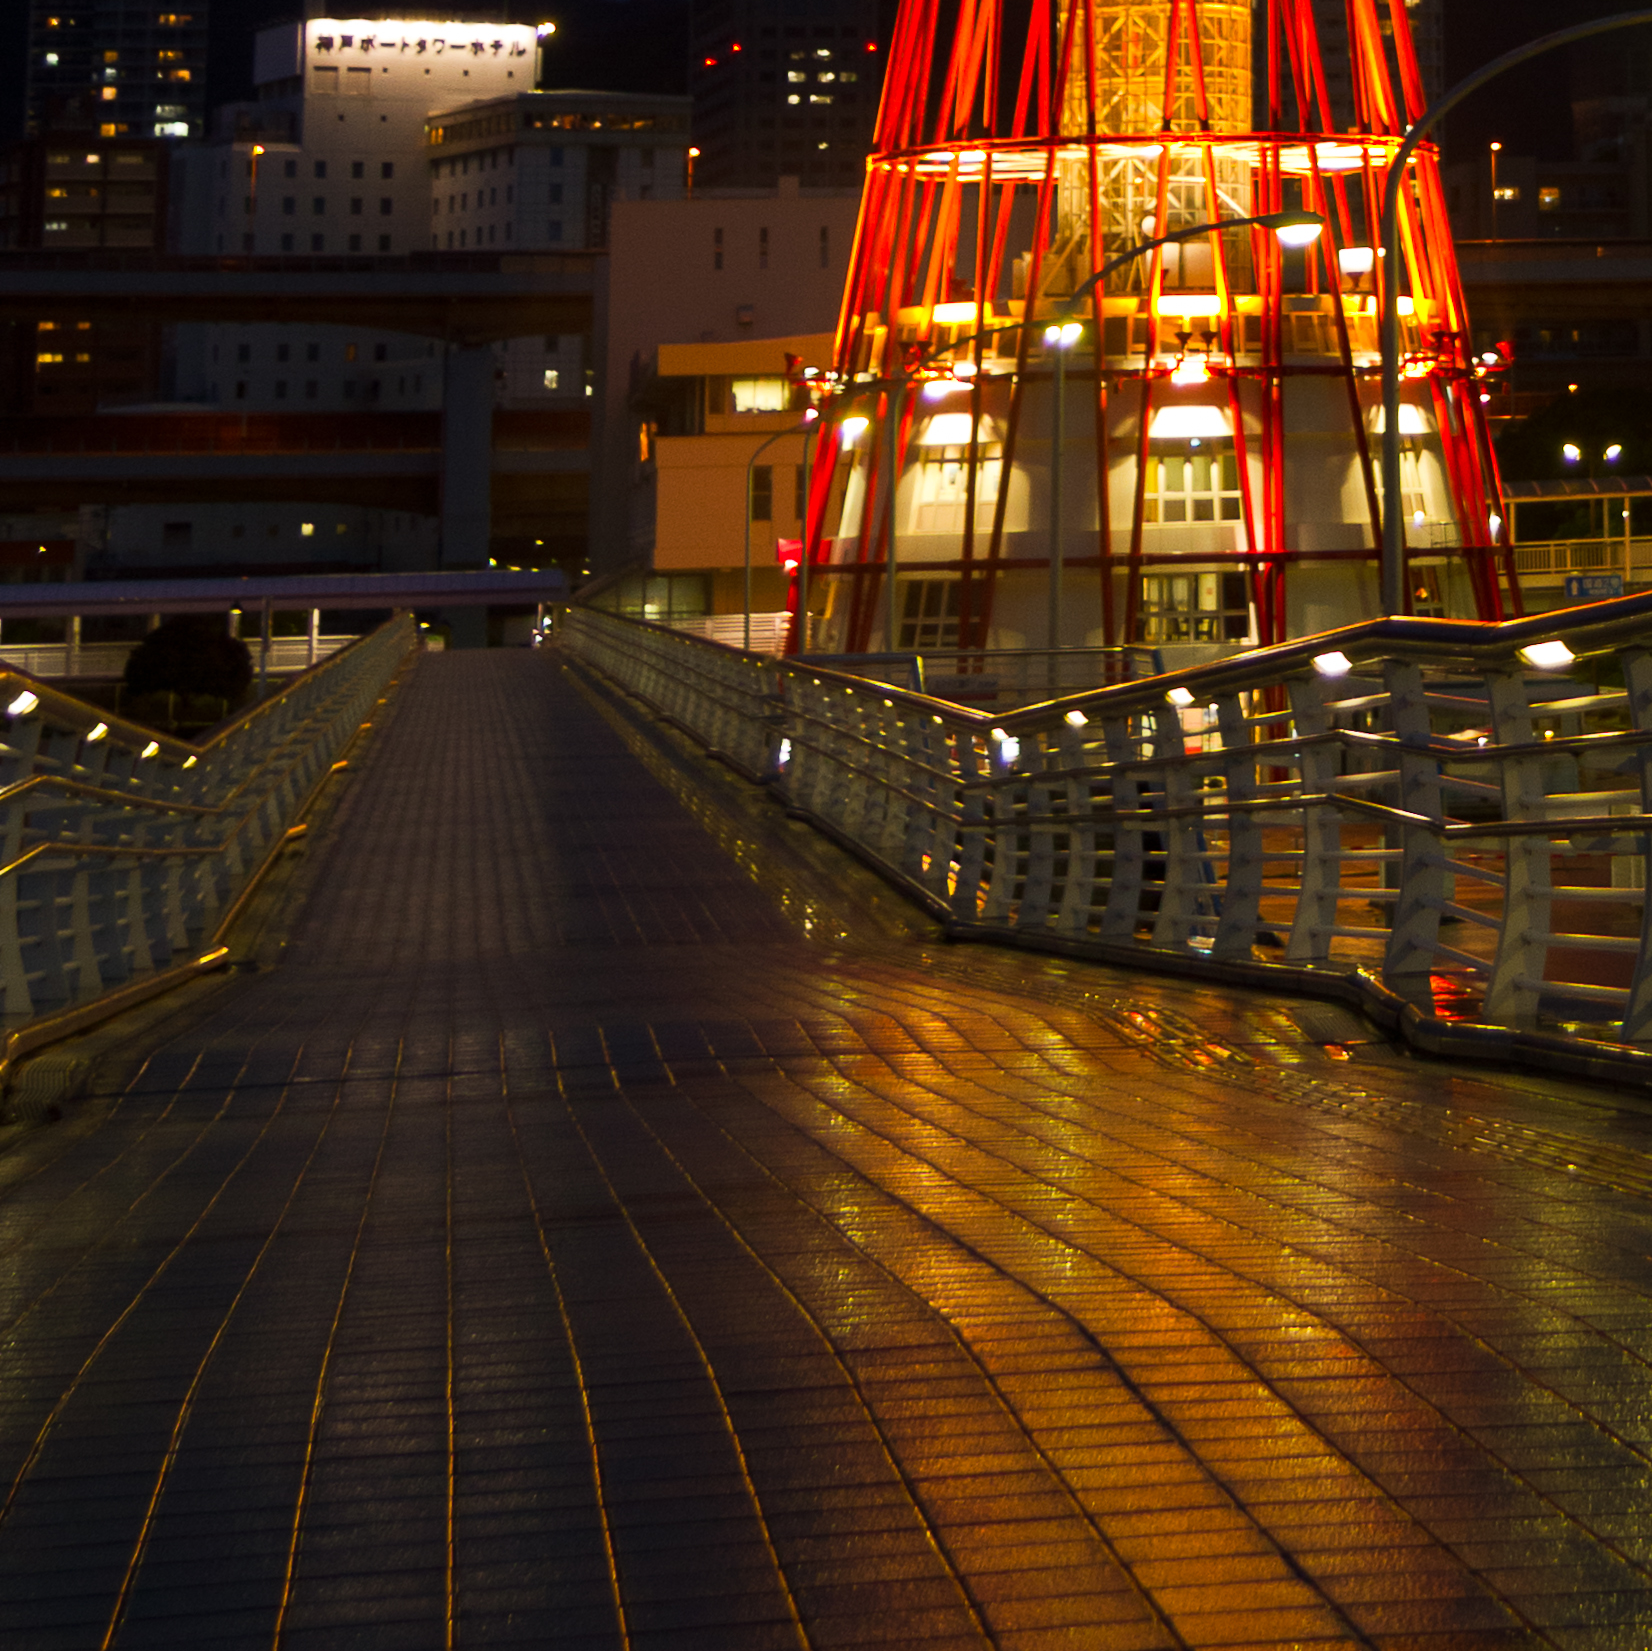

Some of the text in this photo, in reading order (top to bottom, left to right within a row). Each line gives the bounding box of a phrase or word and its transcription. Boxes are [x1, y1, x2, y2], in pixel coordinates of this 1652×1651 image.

[315, 33, 527, 57] 神戸ポートタワーホテル
